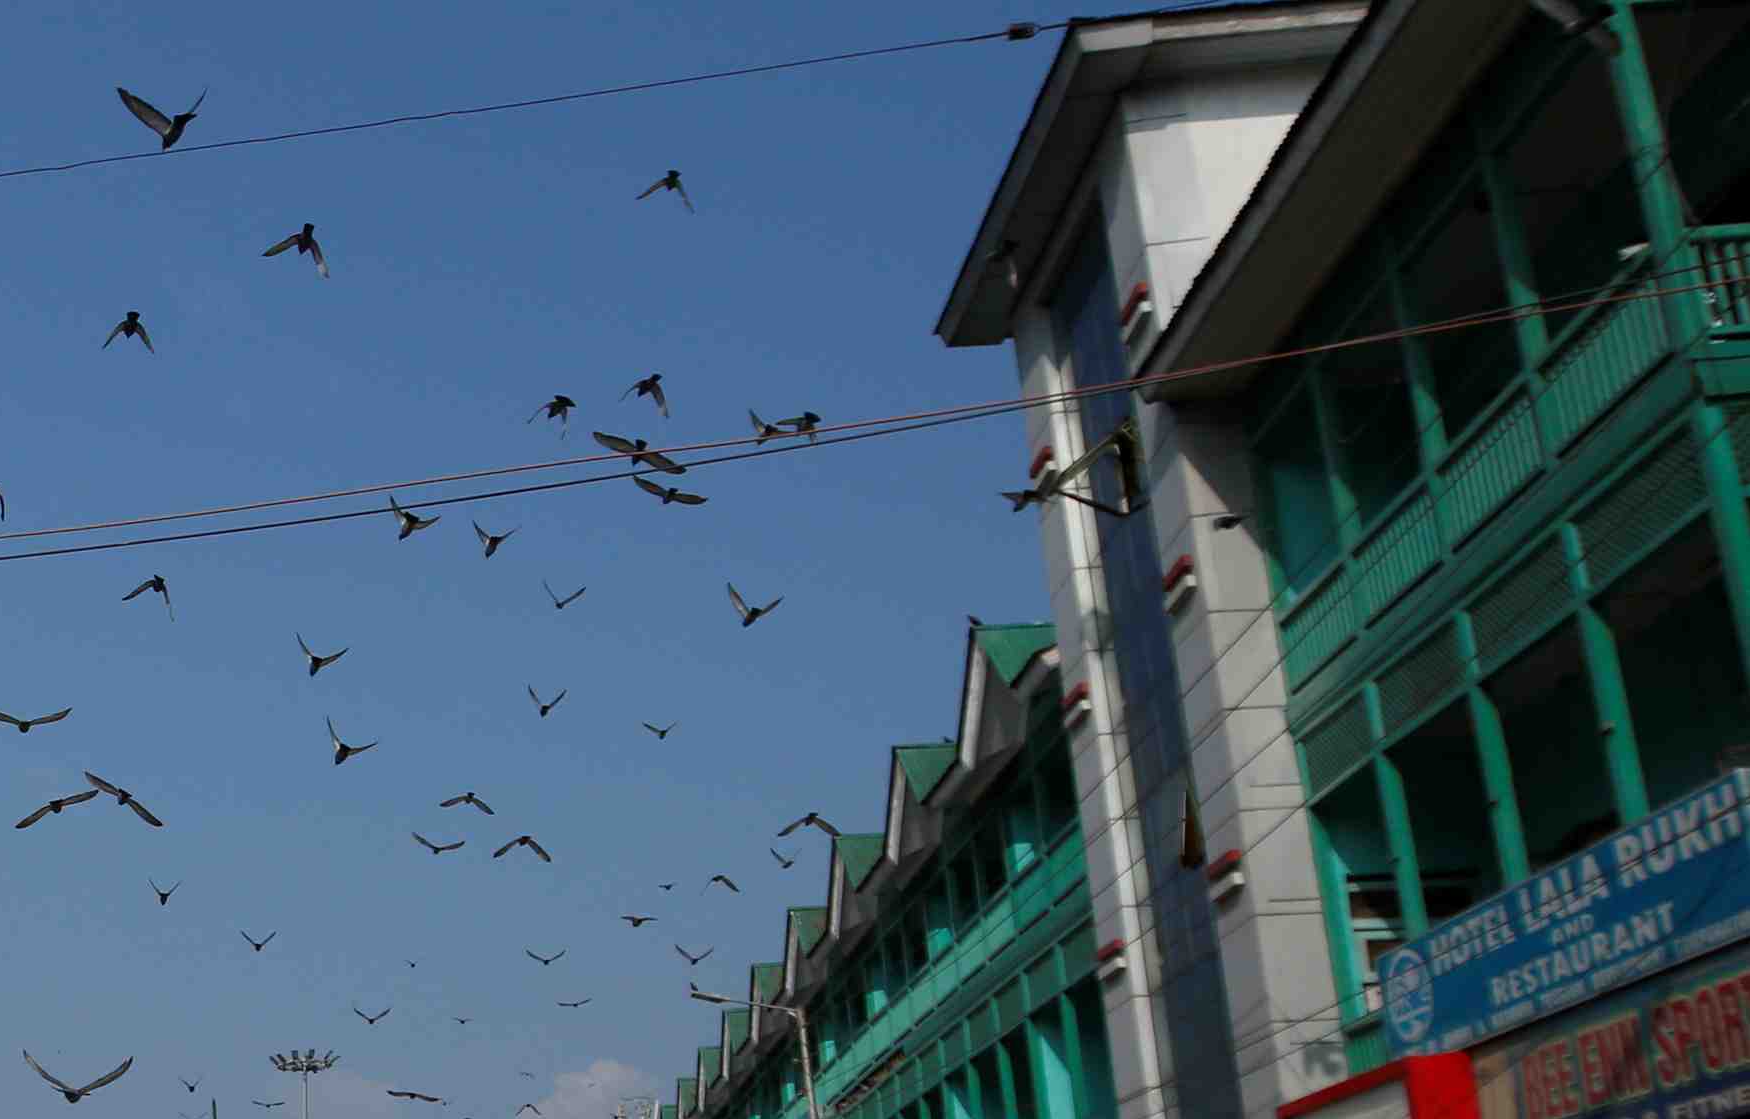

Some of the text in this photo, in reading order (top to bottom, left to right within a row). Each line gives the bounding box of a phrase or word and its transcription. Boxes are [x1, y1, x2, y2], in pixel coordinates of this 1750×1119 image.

[1428, 903, 1516, 976] HOTEL
[1515, 853, 1612, 935] LALA
[1612, 783, 1743, 890] RUKH
[1550, 914, 1596, 946] AND
[1490, 902, 1675, 1007] RESTAURANT
